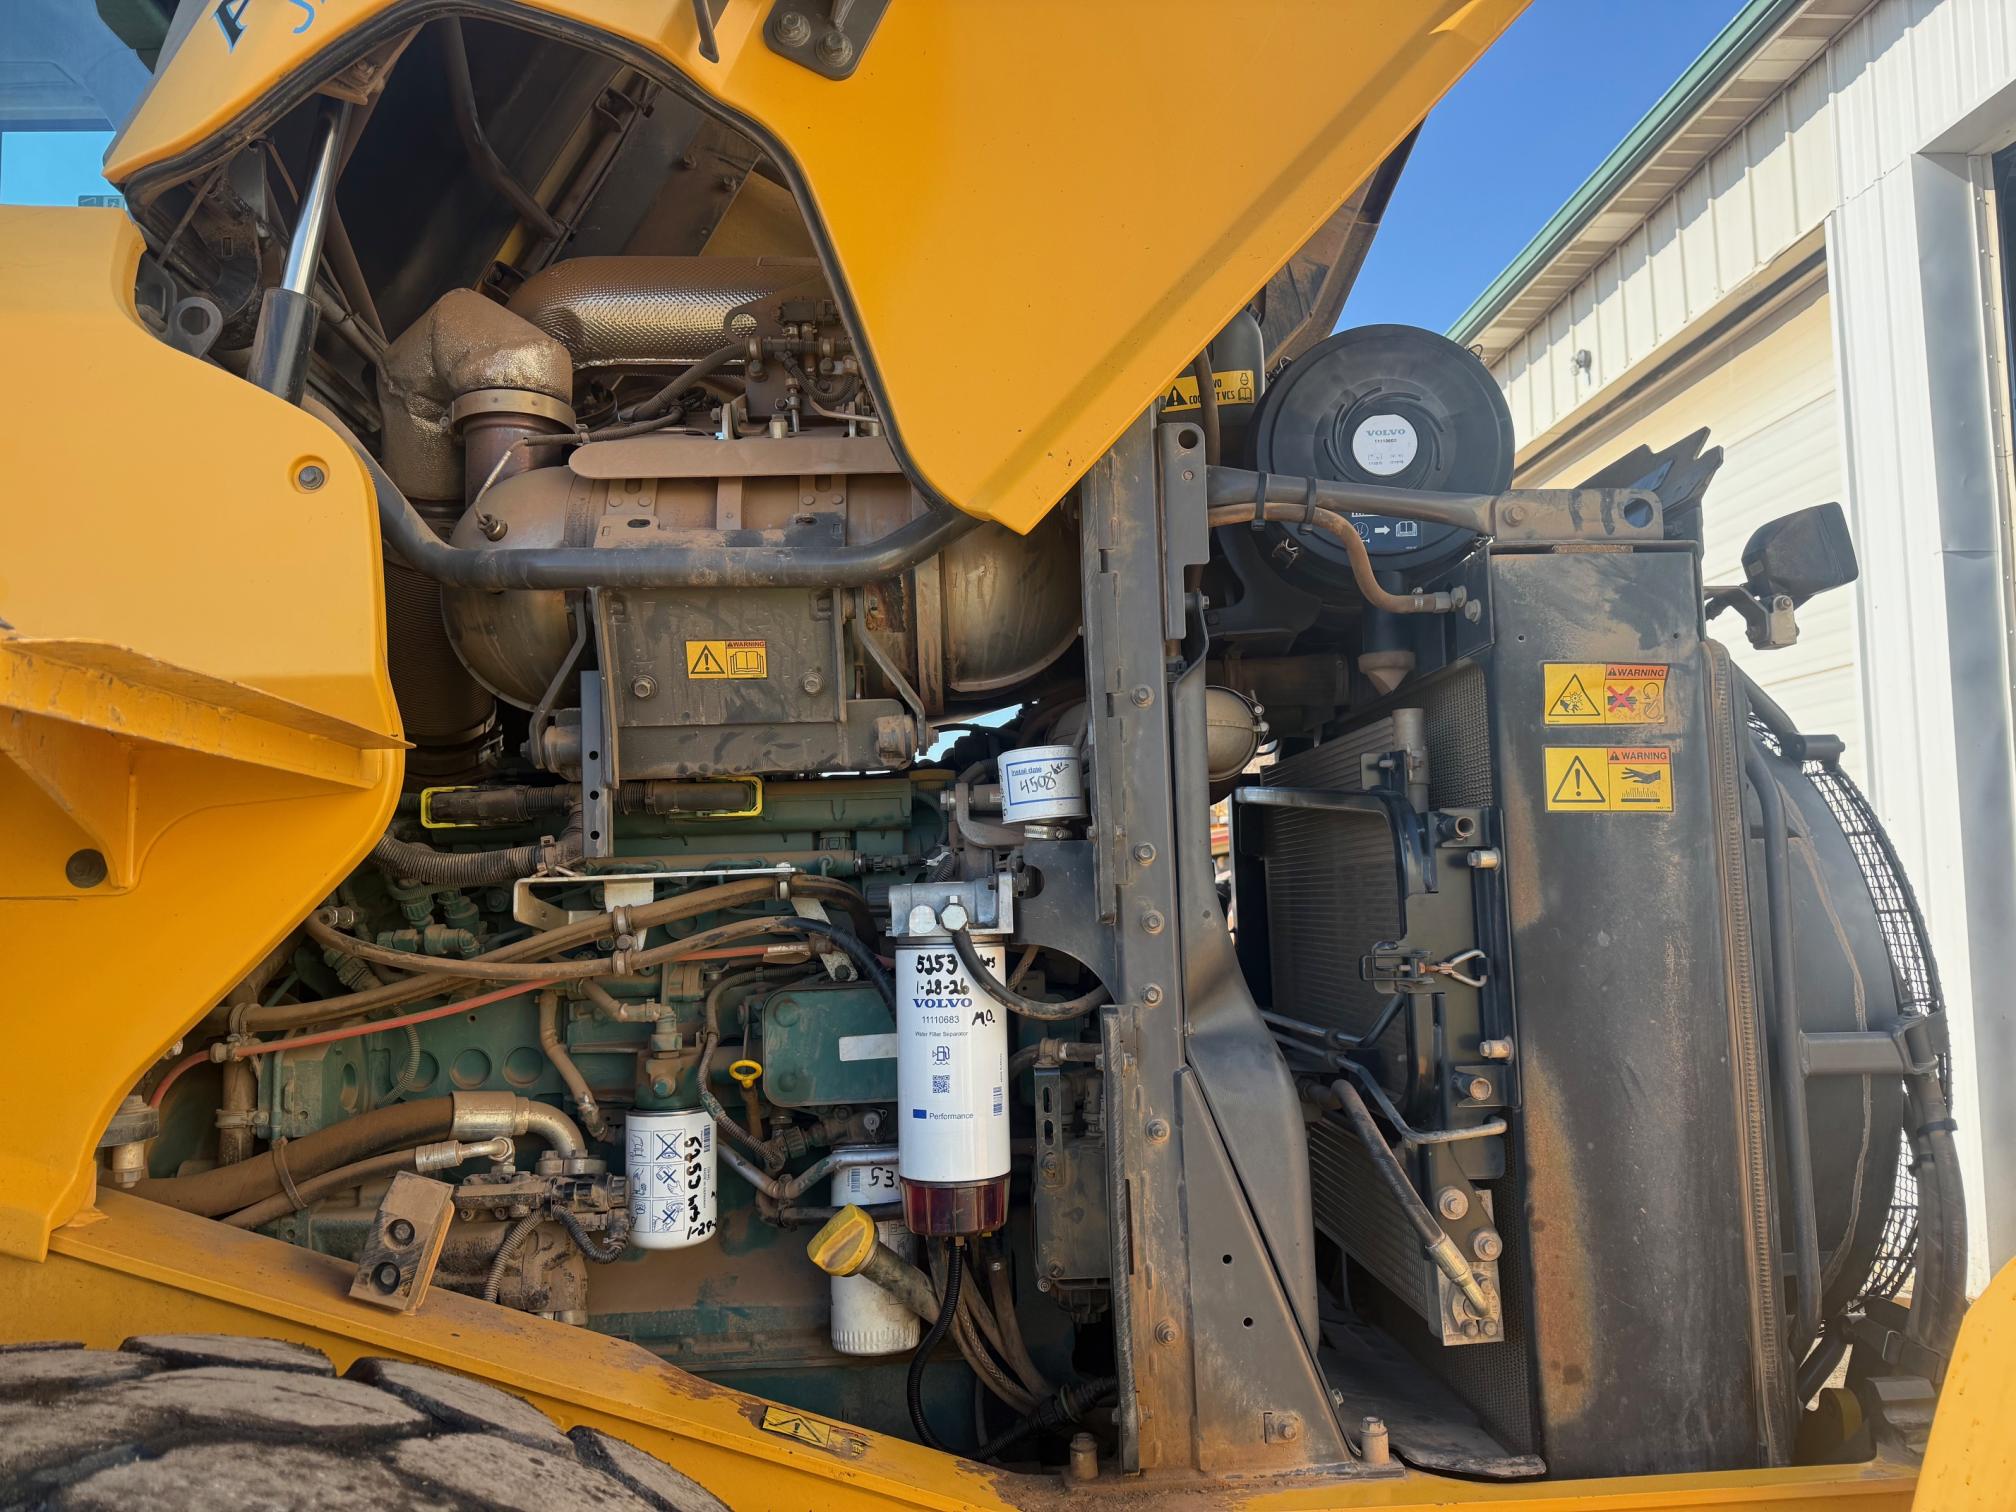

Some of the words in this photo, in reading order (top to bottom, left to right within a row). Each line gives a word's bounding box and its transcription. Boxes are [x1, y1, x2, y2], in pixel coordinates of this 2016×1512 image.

[1222, 390, 1235, 400] VCS
[1366, 428, 1406, 437] VOLVO
[1617, 669, 1665, 677] WARNING
[1621, 751, 1667, 761] WARNING
[1020, 771, 1057, 794] 4508
[912, 997, 973, 1009] VOLVO
[921, 1015, 960, 1024] 11110683
[929, 1112, 974, 1121] Performance
